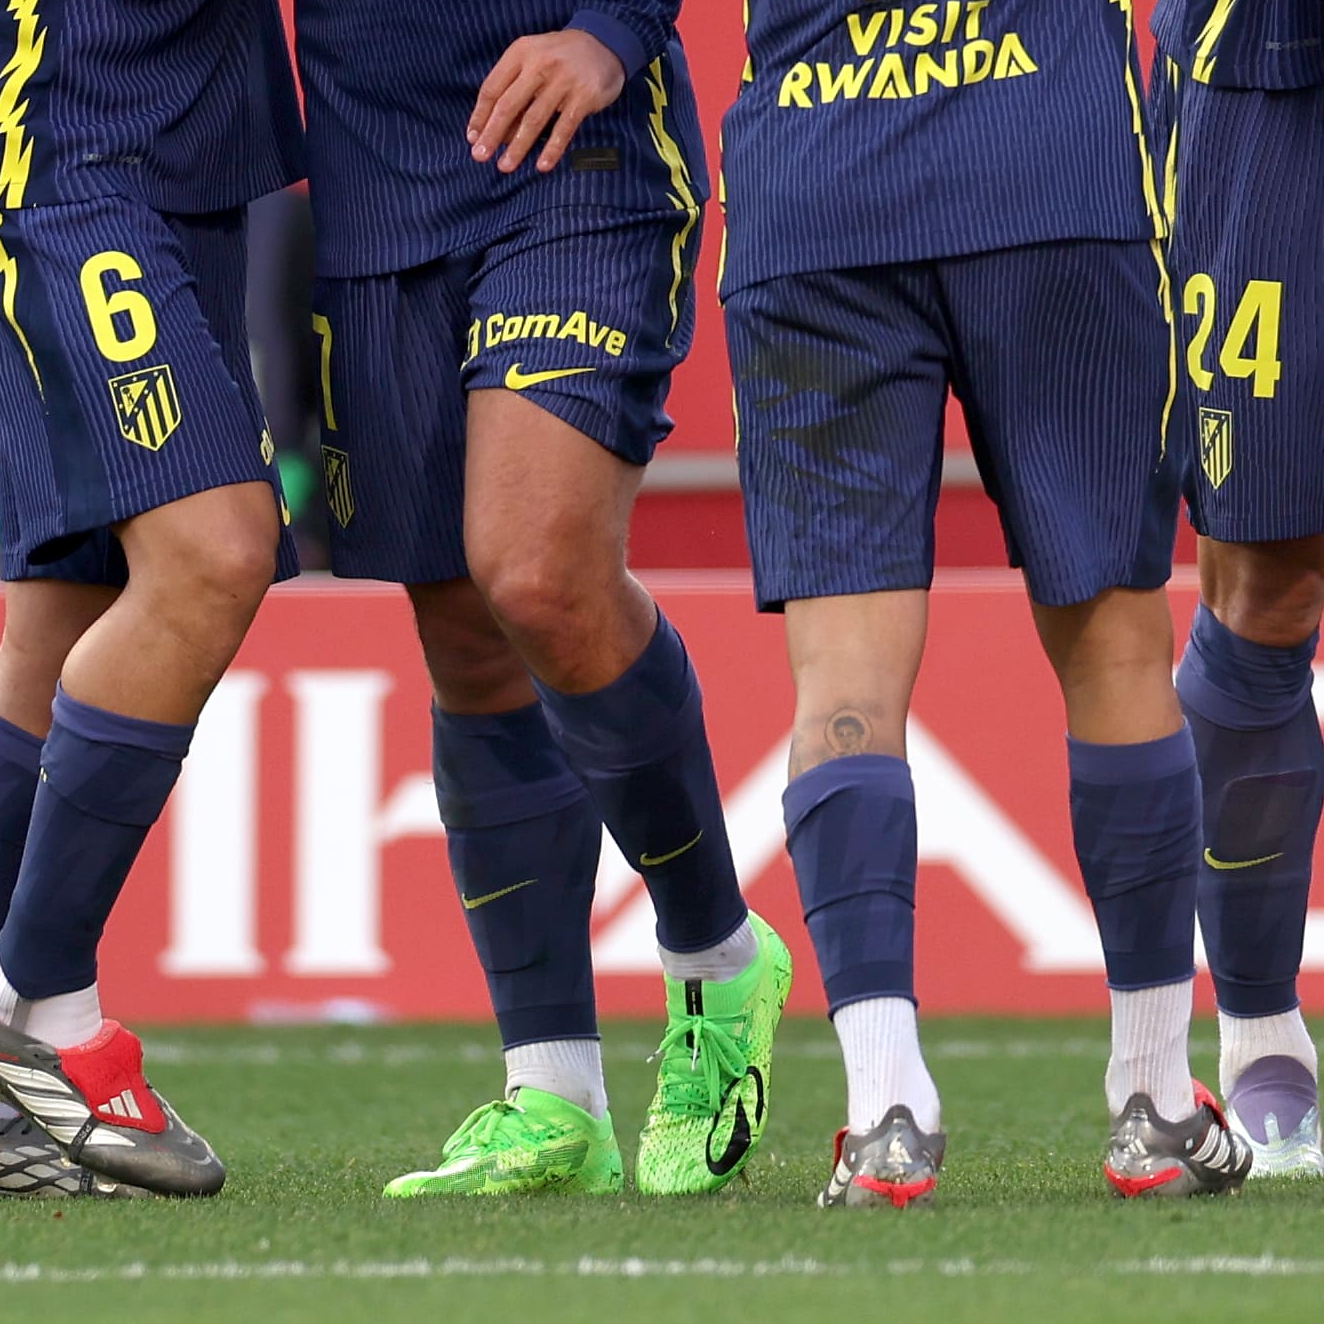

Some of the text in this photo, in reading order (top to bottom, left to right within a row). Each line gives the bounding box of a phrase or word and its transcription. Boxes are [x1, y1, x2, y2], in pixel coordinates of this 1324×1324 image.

[777, 32, 1039, 108] RWANDA
[846, 0, 991, 57] VISIT
[79, 251, 157, 363] 6
[485, 310, 627, 357] ComAve
[1182, 272, 1283, 399] 24
[312, 312, 339, 432] 7
